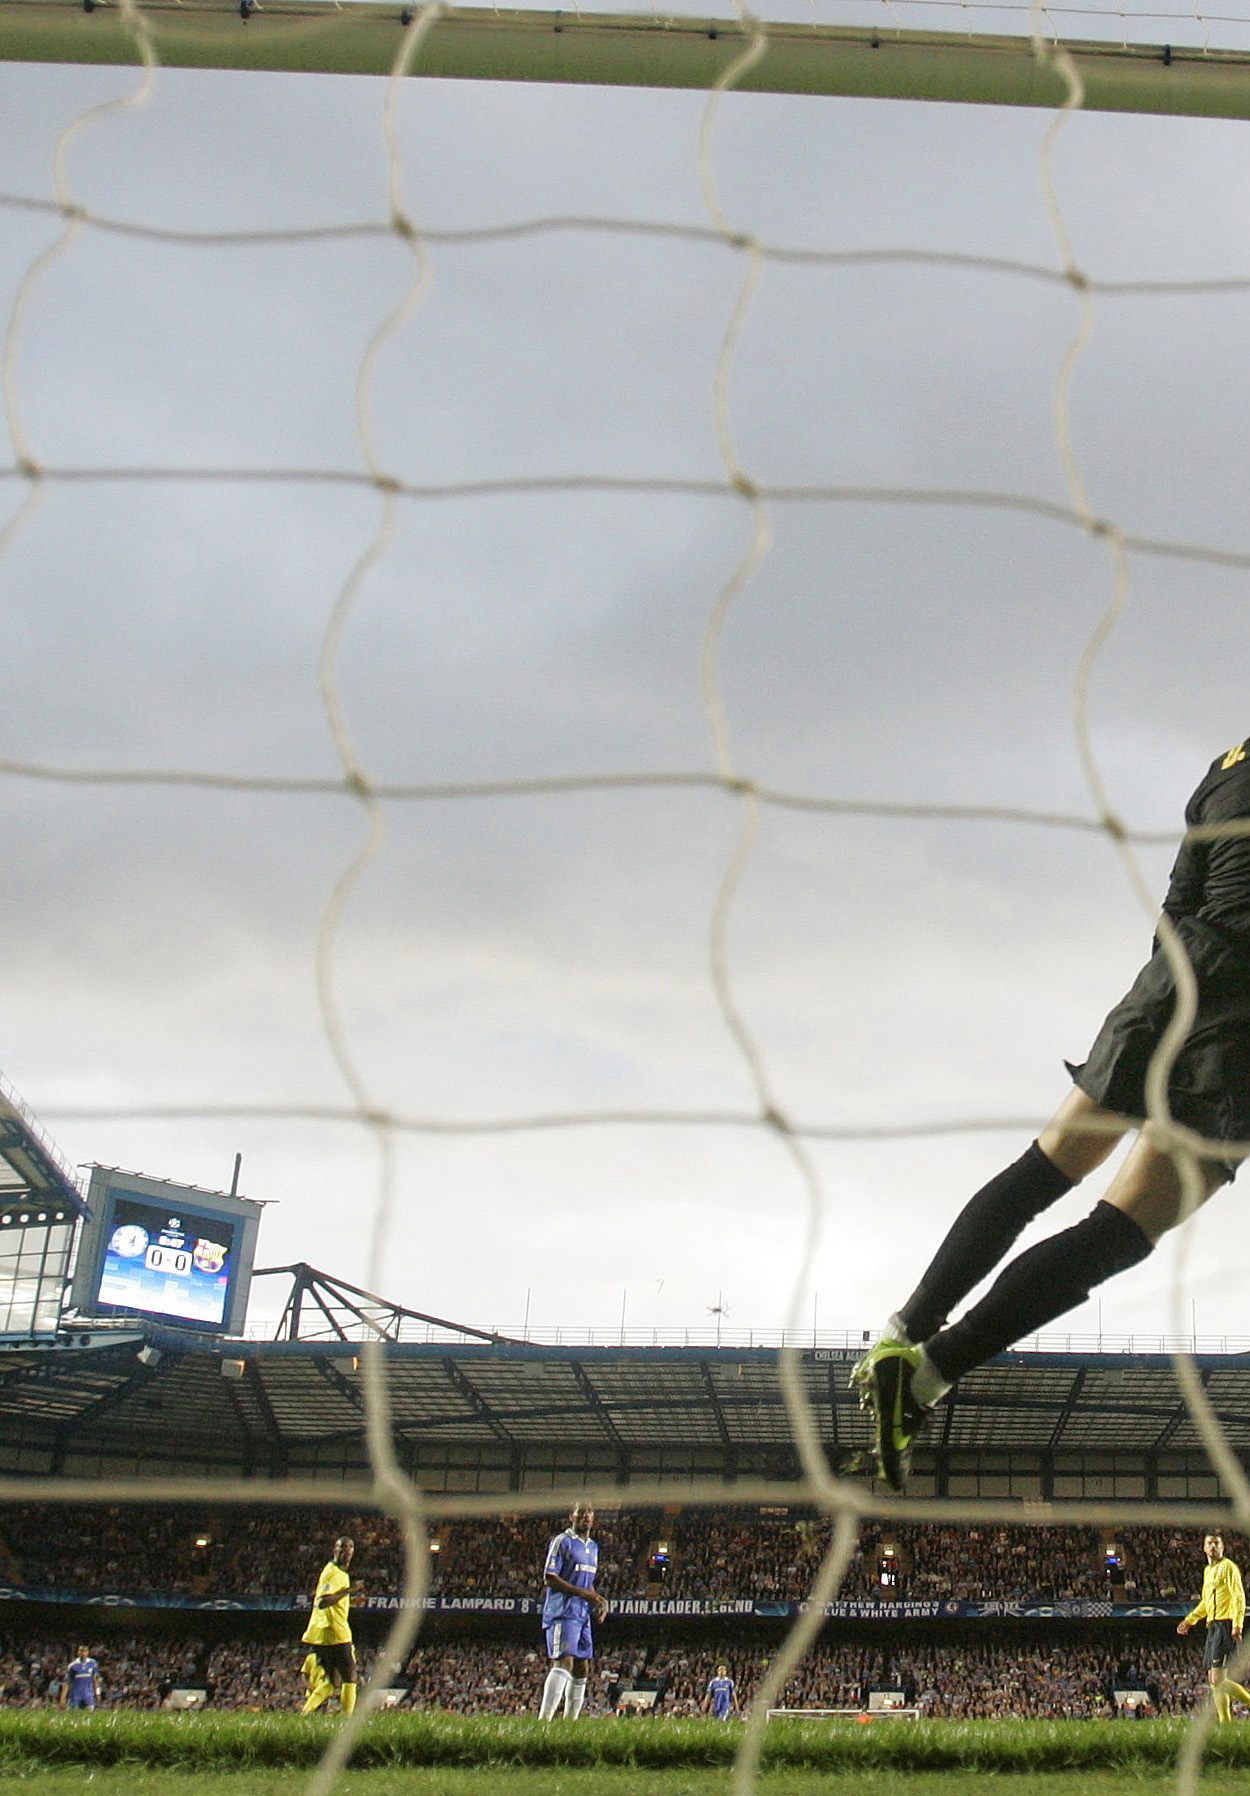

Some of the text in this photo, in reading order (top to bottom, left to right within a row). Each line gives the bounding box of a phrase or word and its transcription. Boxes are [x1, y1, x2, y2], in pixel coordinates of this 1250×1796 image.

[441, 1598, 515, 1611] LAMPARD
[860, 1609, 898, 1618] WHITE
[904, 1608, 939, 1617] ARMY
